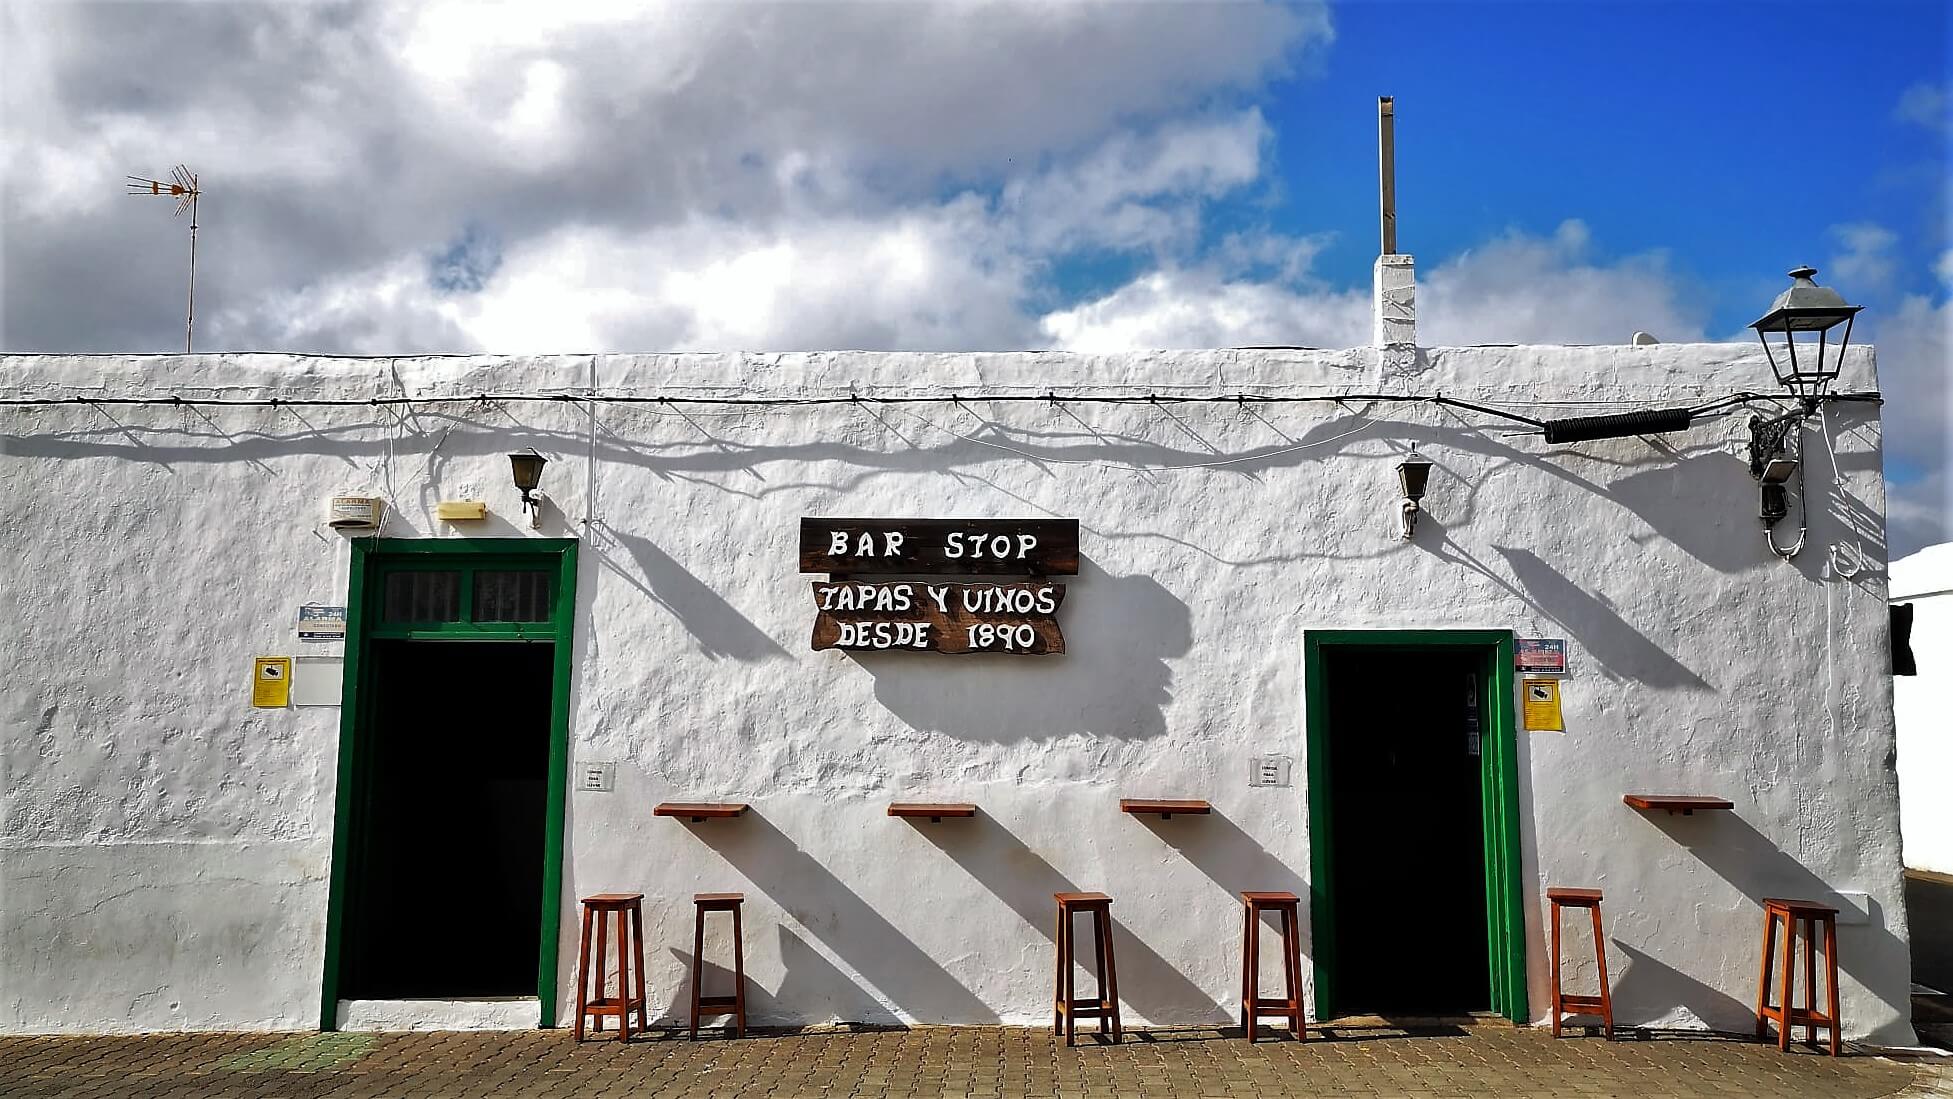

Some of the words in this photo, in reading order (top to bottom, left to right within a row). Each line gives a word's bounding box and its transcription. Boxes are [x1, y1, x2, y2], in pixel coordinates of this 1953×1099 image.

[828, 531, 904, 557] BAR
[944, 532, 1037, 559] STOP
[818, 584, 914, 612] TAPAS
[927, 585, 950, 613] Y
[834, 620, 931, 648] DESDE
[965, 623, 1035, 650] 1890
